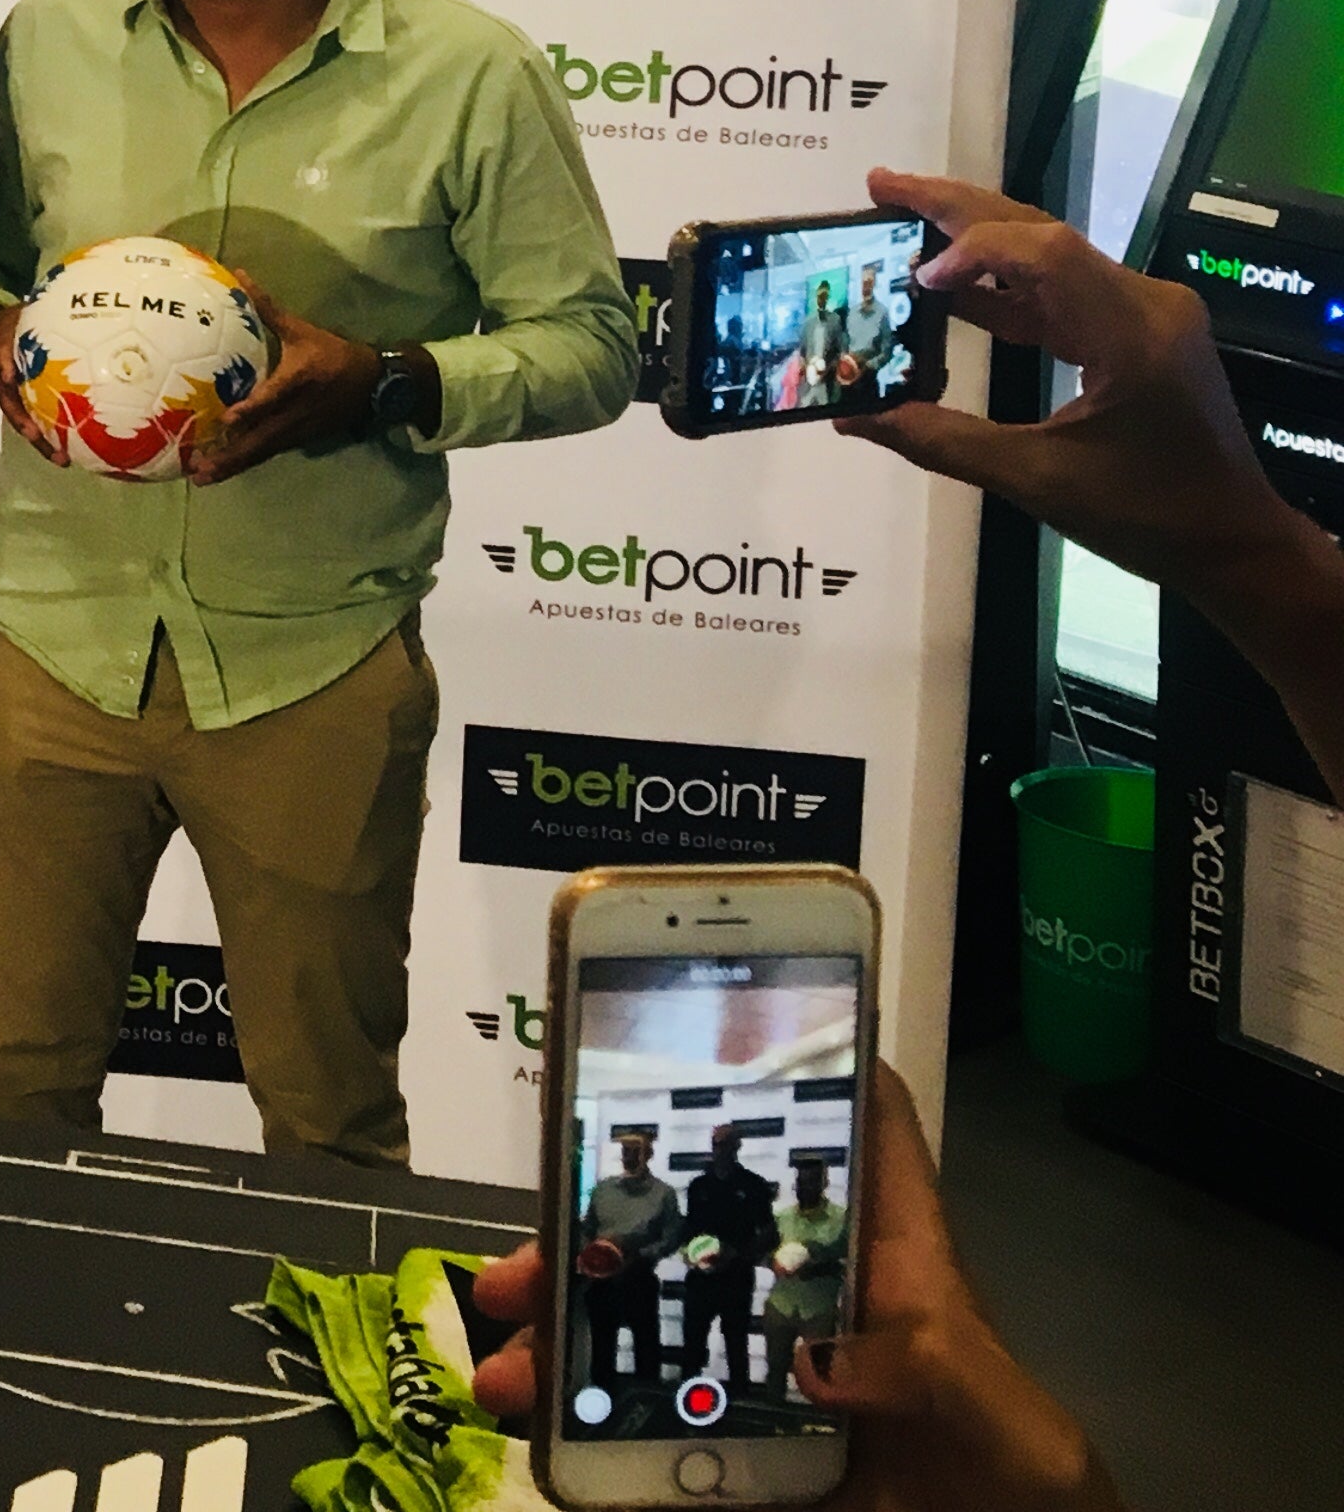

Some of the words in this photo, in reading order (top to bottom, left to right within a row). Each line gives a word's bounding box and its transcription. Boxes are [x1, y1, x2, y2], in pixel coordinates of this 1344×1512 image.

[546, 43, 842, 118] betpoint
[574, 122, 667, 144] uestas
[677, 124, 708, 143] de
[719, 127, 828, 150] Baleares
[1200, 249, 1304, 295] betpoint
[71, 291, 186, 319] KELME
[1263, 422, 1344, 464] Apuesta
[523, 526, 814, 600] betpoint
[529, 599, 641, 624] Apuestas
[652, 605, 684, 627] de
[695, 611, 801, 635] Baleares
[526, 754, 787, 821] betpoint
[532, 818, 630, 843] Apuestas
[644, 826, 669, 847] de
[680, 831, 776, 854] Baleares
[1190, 815, 1225, 1003] BETBOX
[181, 1029, 207, 1046] de
